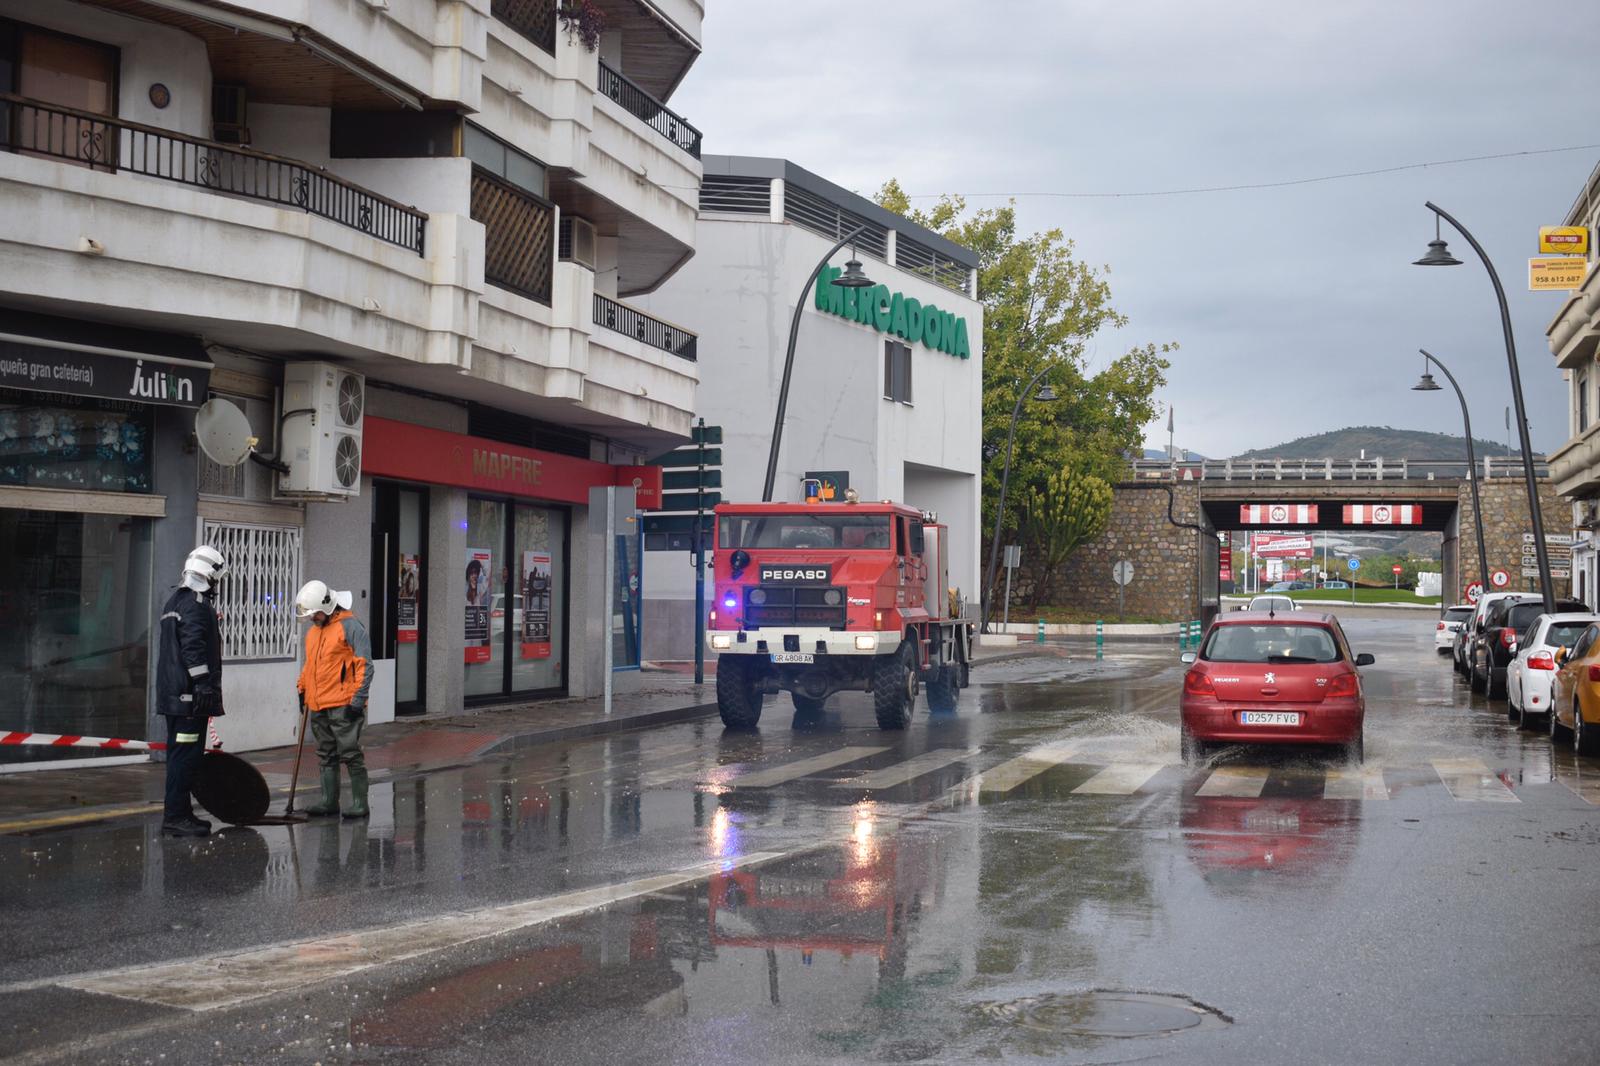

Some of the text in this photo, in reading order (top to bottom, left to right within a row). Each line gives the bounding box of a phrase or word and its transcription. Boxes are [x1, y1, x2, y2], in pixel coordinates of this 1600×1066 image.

[815, 262, 970, 360] MERCADONA
[30, 363, 51, 381] gran
[472, 448, 544, 486] MAPFRE
[762, 569, 827, 580] PEGASO
[785, 654, 803, 662] 4808
[1248, 712, 1297, 724] 0257 FVG
